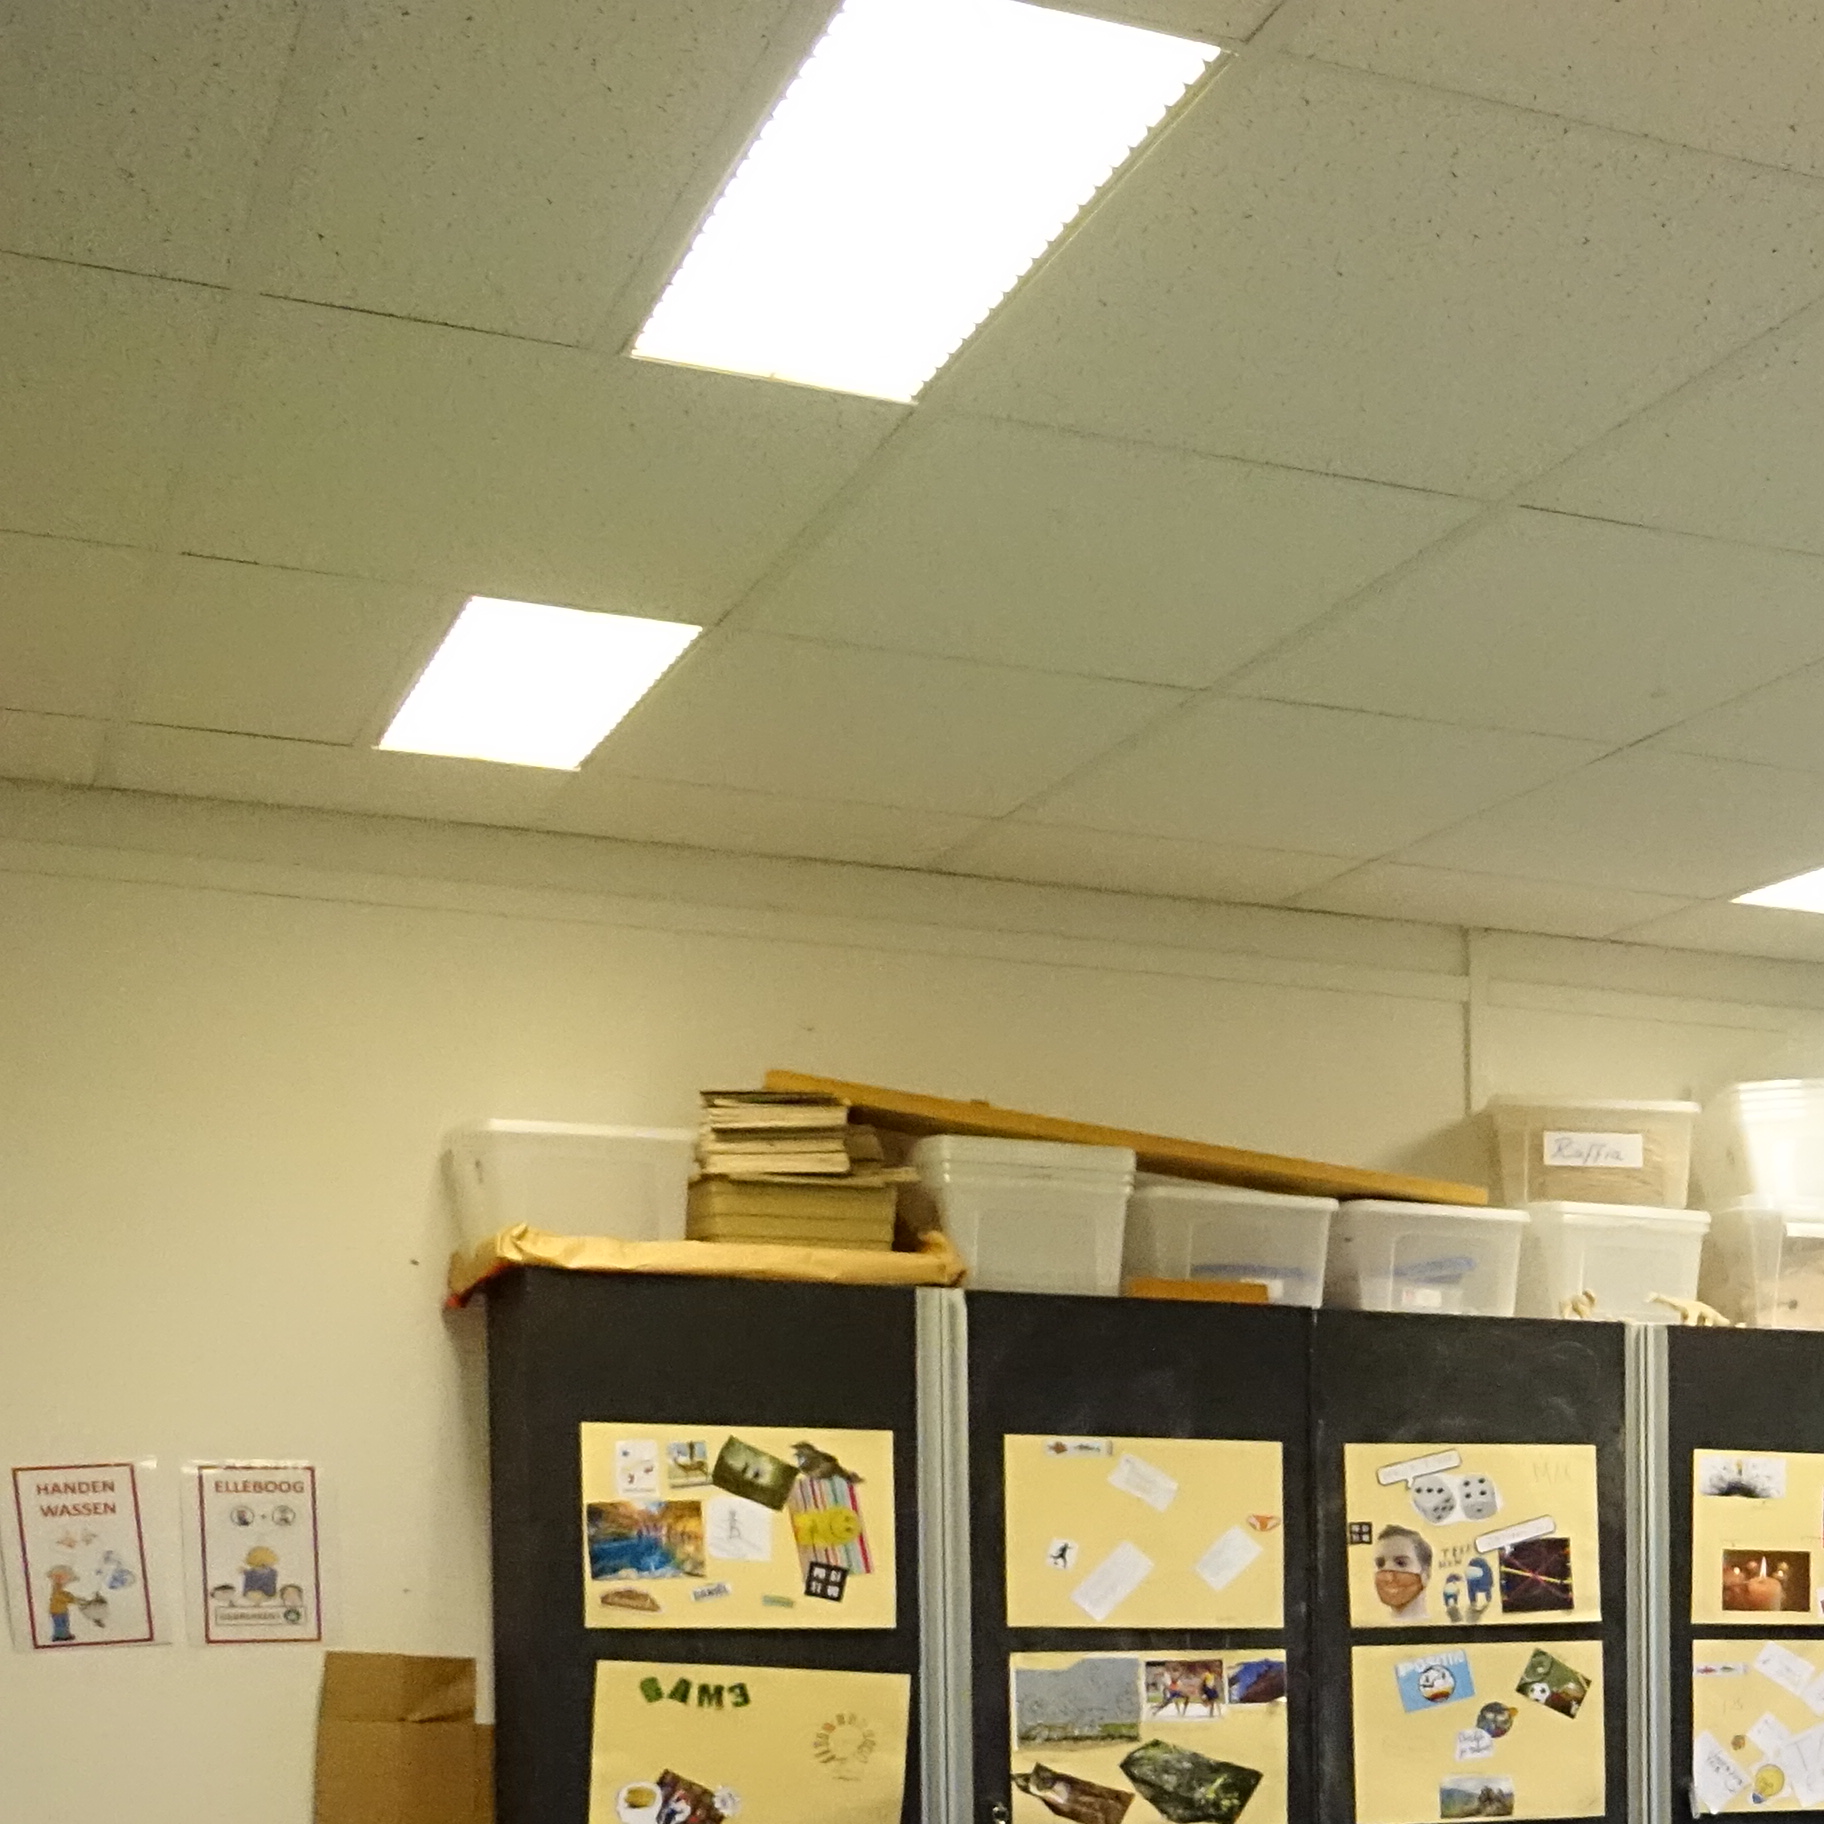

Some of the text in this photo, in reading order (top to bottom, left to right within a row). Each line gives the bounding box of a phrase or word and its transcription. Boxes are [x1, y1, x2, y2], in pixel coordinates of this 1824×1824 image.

[36, 1479, 116, 1496] HANDEN
[213, 1480, 305, 1494] ELLEBOOG
[40, 1501, 117, 1518] WASSEN
